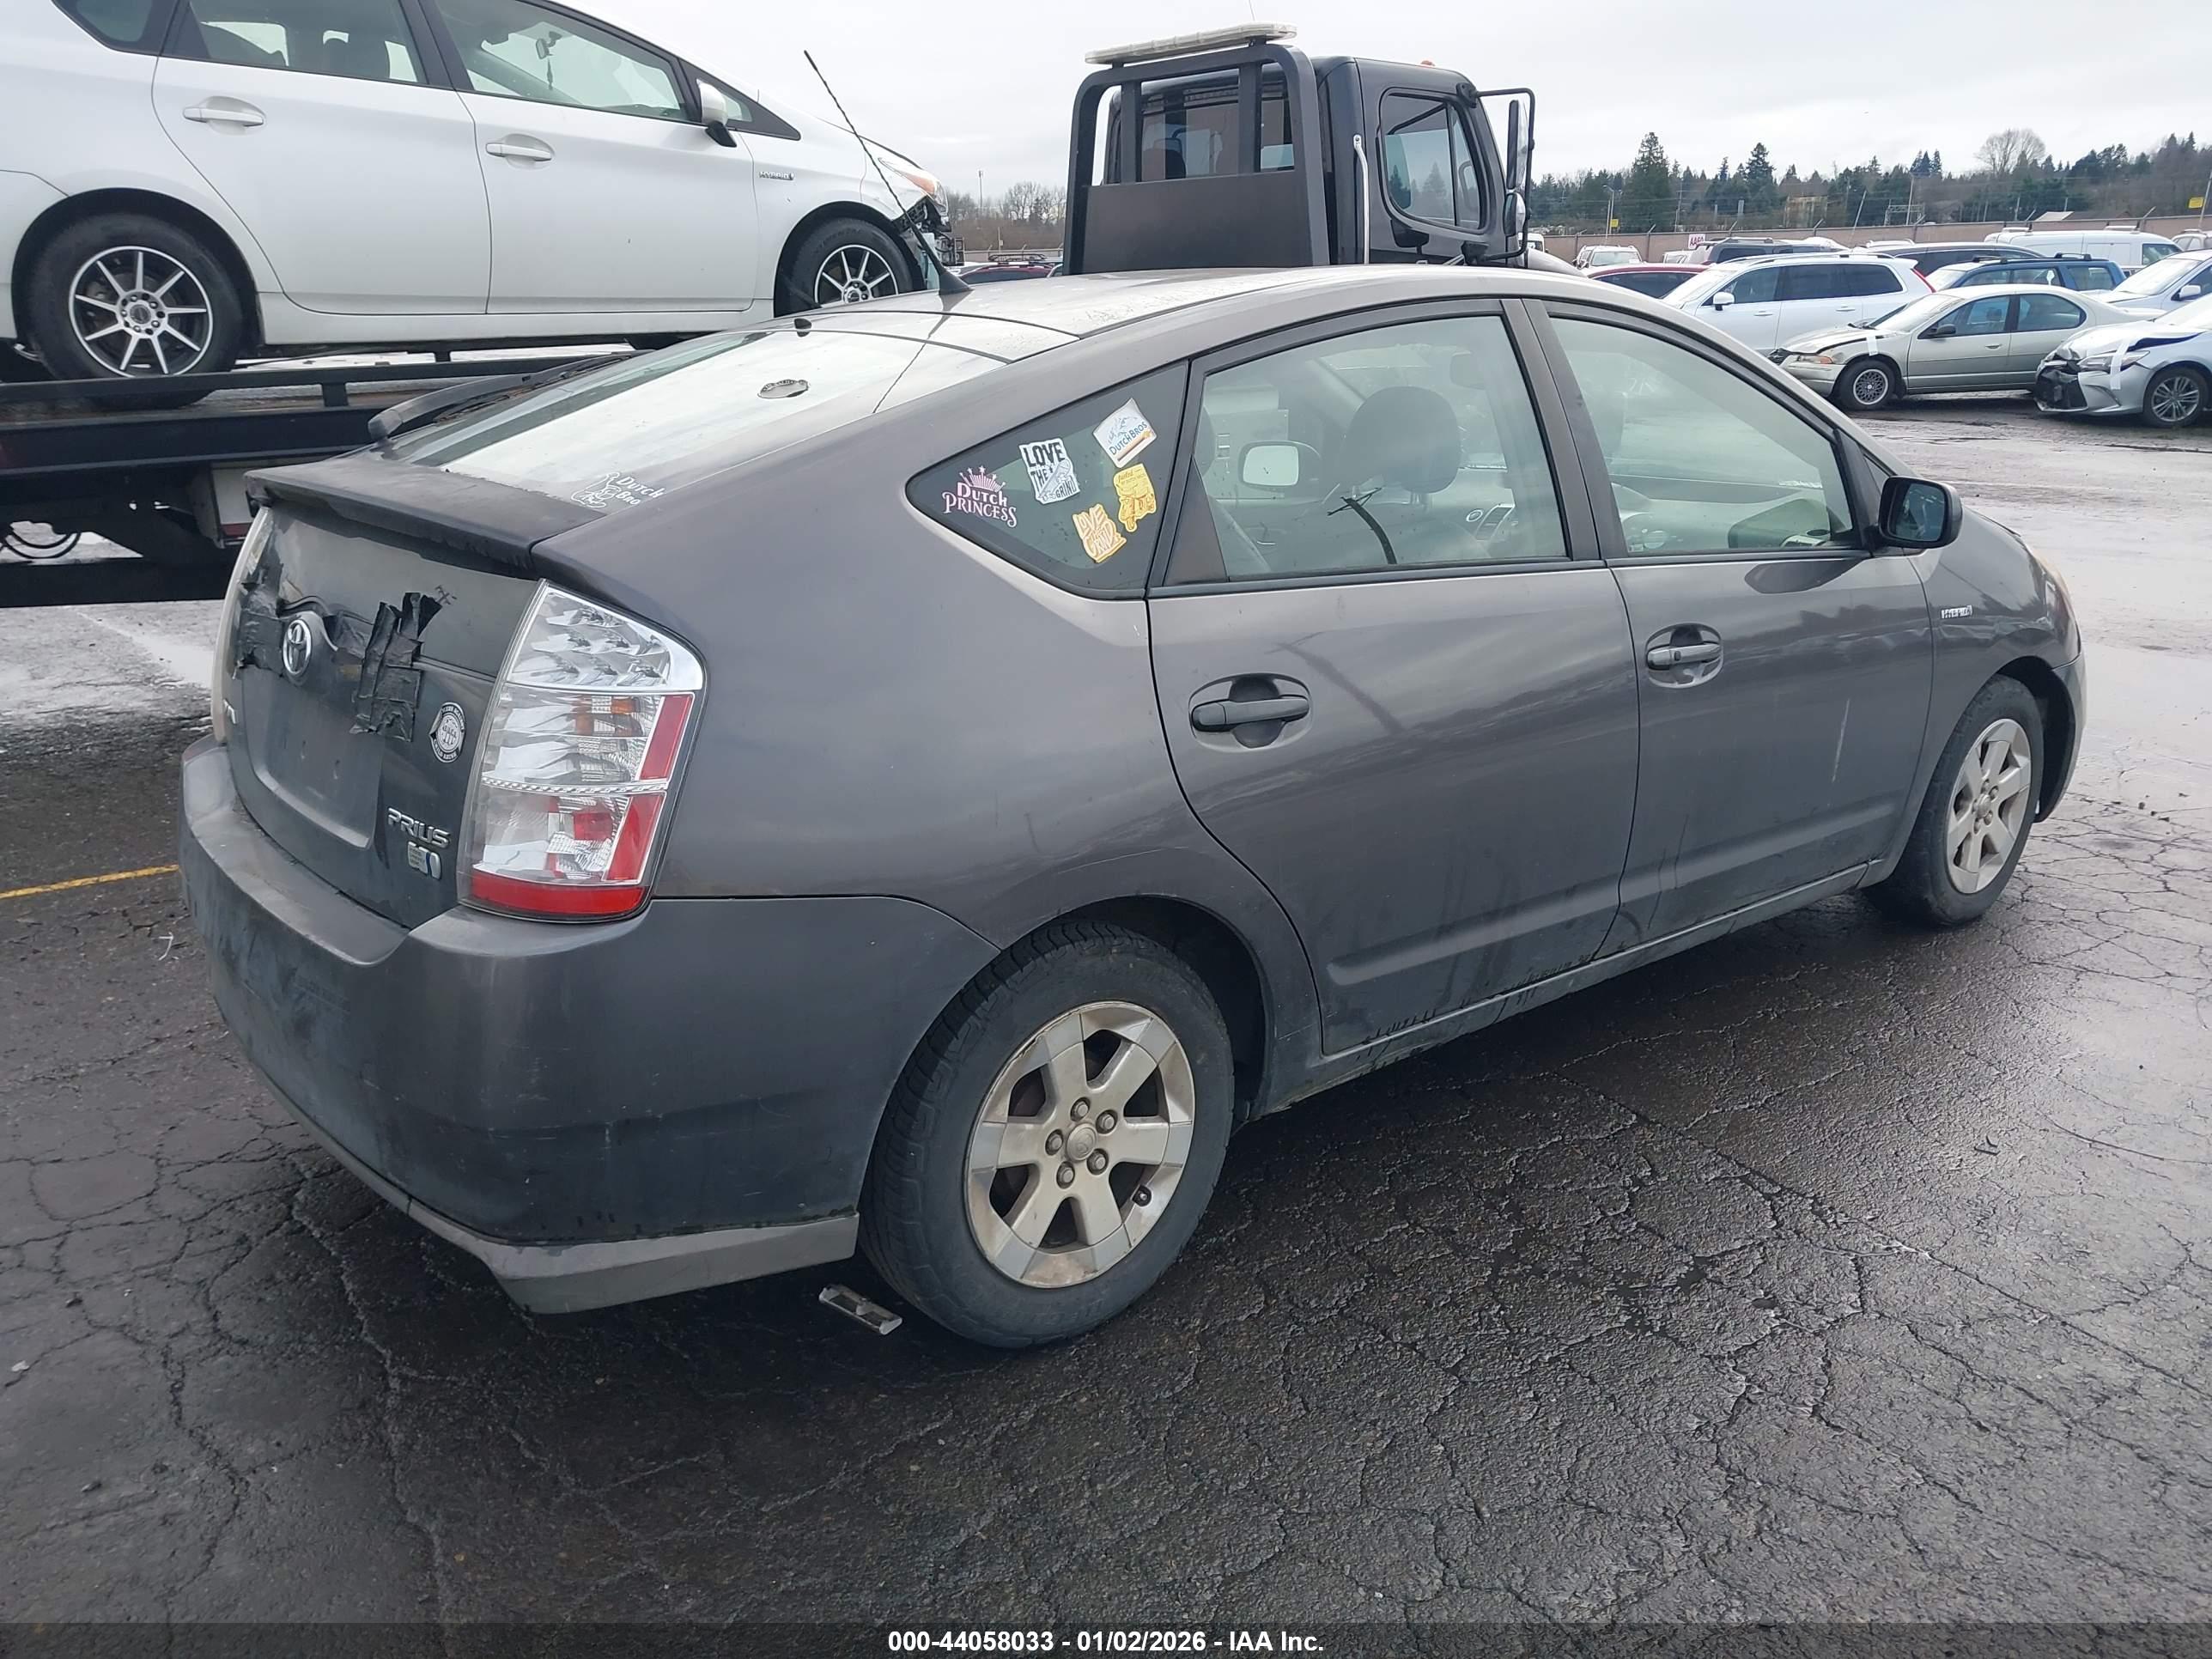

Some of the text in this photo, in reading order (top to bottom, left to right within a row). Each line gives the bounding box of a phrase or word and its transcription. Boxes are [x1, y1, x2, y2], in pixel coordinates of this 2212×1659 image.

[1023, 442, 1066, 468] LOVE
[1030, 469, 1048, 498] THE
[942, 491, 1018, 528] PRINCESS
[387, 807, 451, 848] PRIUS
